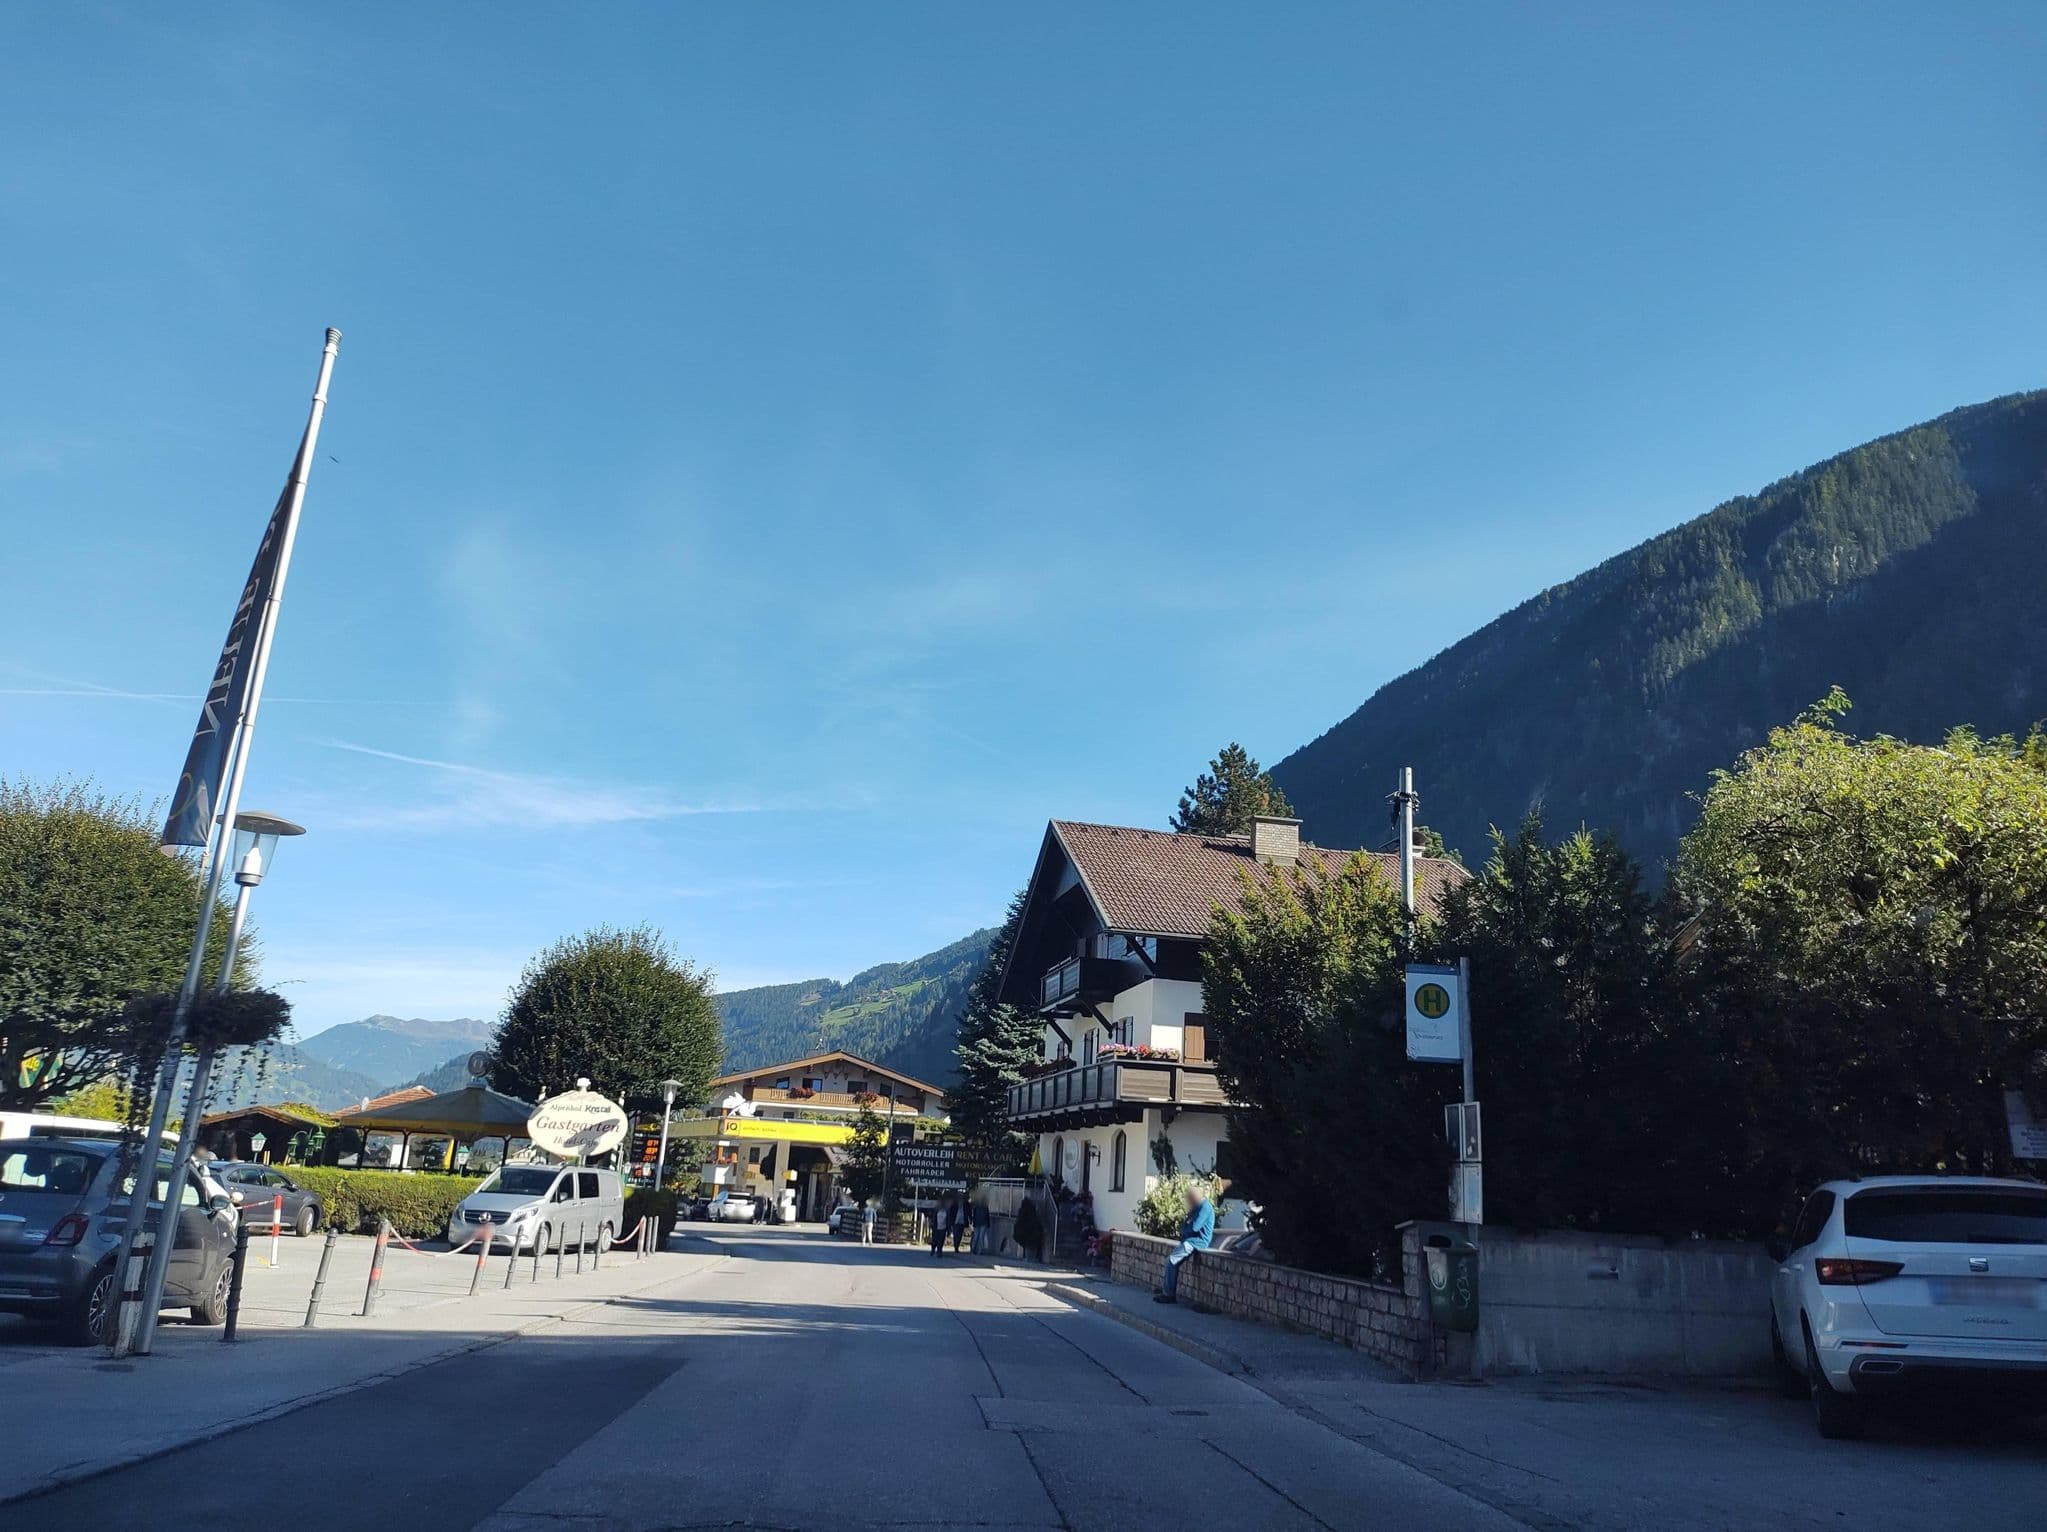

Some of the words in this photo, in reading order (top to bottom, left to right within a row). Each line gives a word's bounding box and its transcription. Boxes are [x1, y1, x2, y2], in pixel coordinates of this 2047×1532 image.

[1424, 989, 1440, 1012] H
[536, 1116, 621, 1135] Gastgarten
[894, 1147, 955, 1159] AUTOVERLEIH
[895, 1159, 950, 1169] MOTORROLLER
